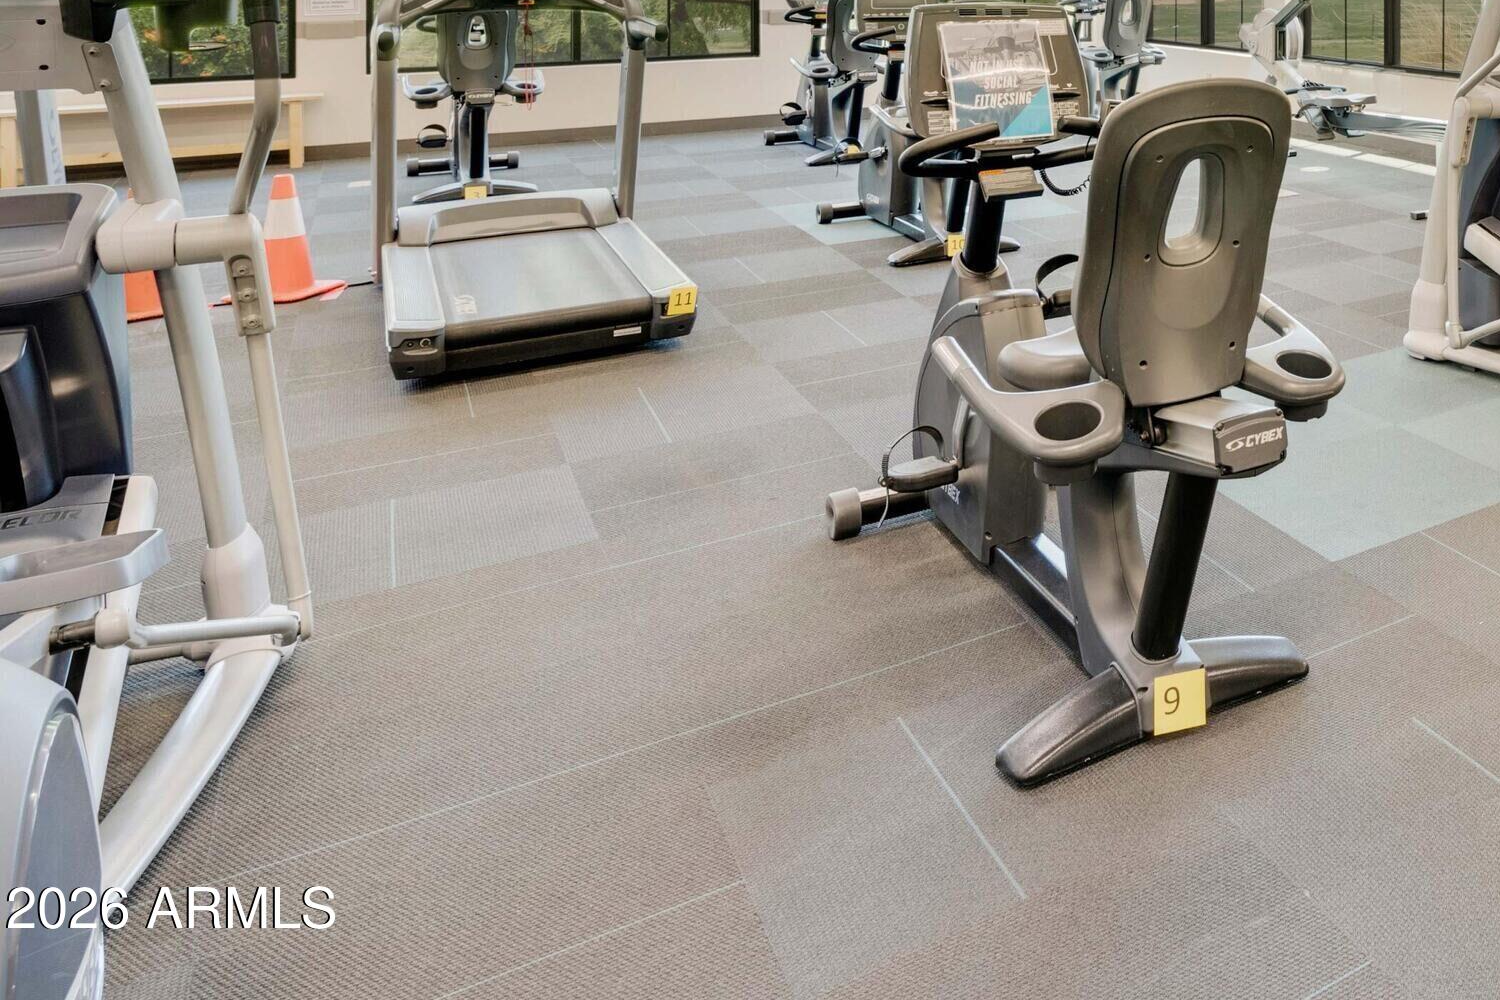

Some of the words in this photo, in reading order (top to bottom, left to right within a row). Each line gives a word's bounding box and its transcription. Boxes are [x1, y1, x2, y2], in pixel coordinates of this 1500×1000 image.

[970, 60, 989, 74] NOT
[984, 75, 1018, 90] SOCIAL
[975, 91, 1032, 109] FITNESSING
[675, 291, 692, 306] 11
[1246, 426, 1284, 447] CYBEX
[1163, 686, 1180, 715] 9
